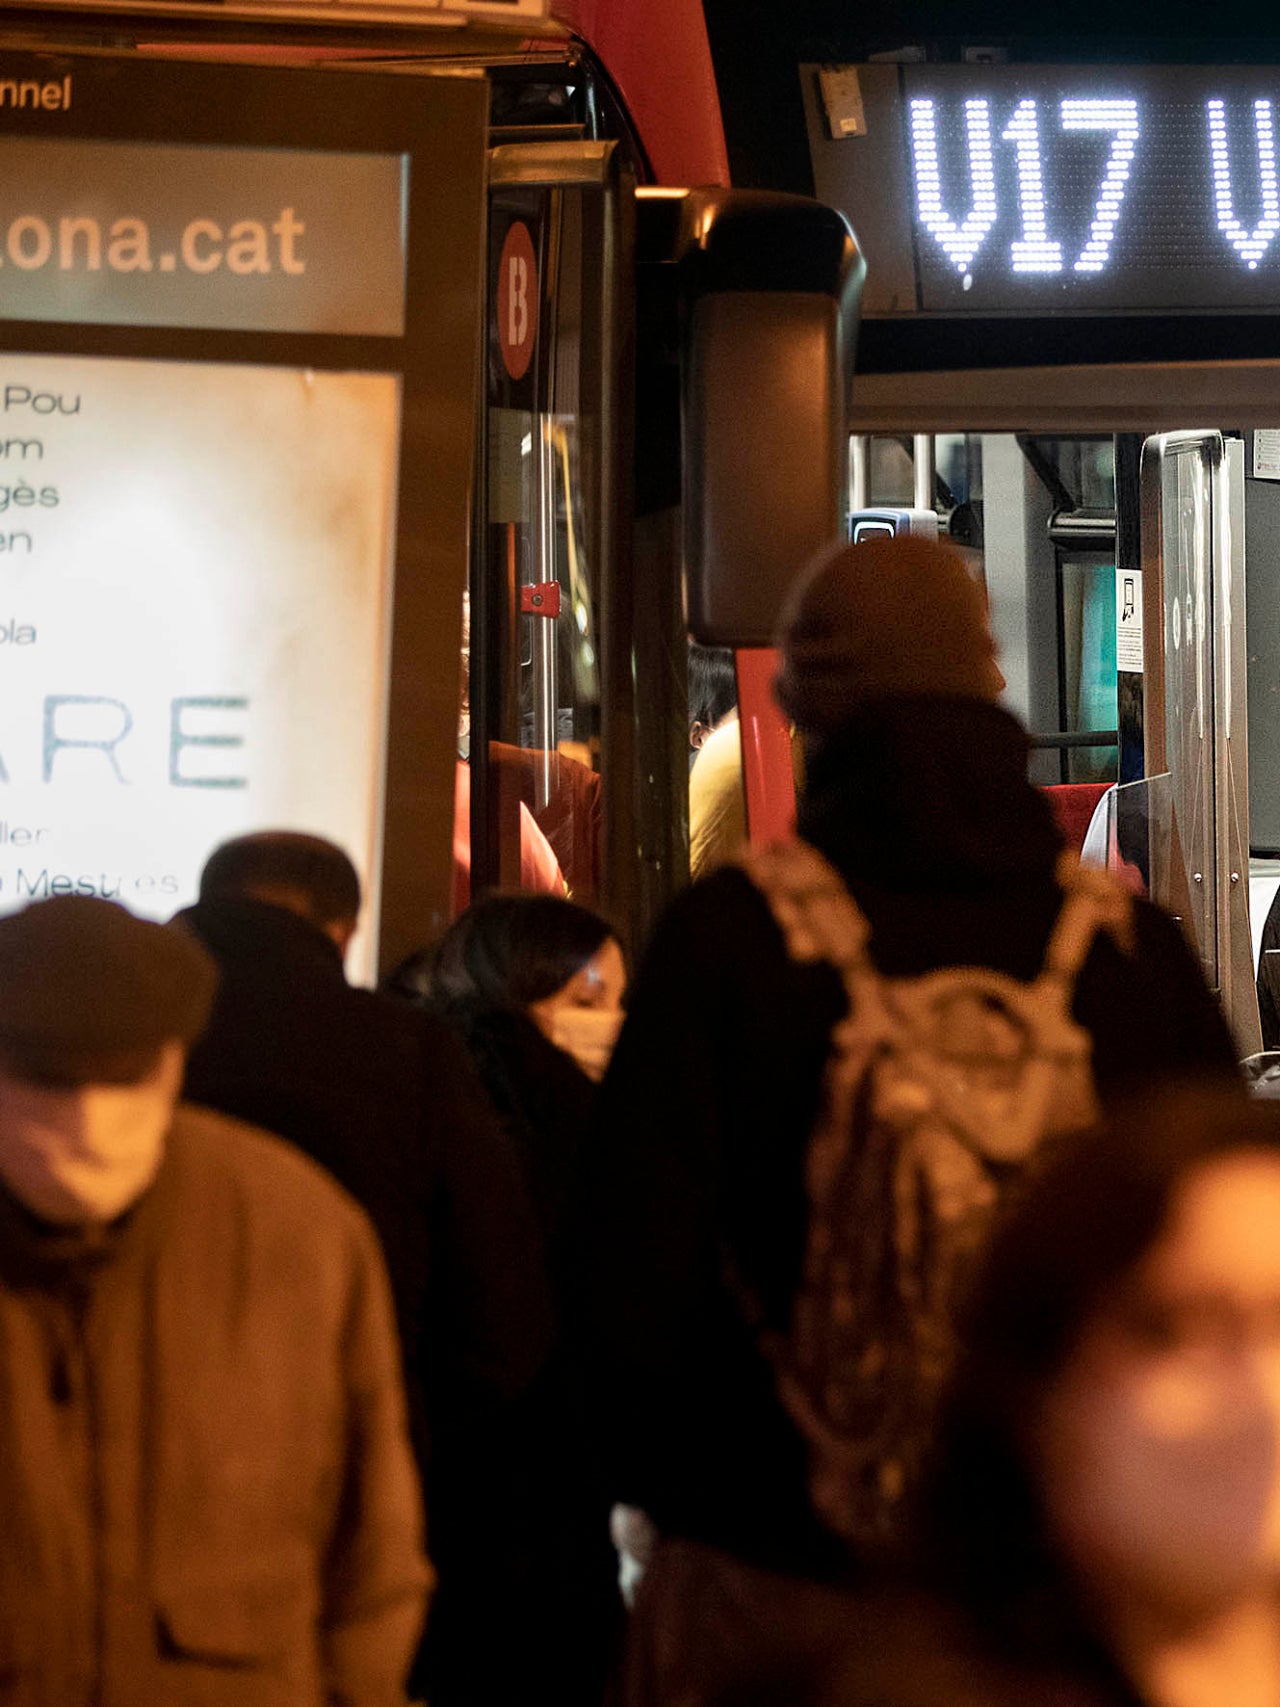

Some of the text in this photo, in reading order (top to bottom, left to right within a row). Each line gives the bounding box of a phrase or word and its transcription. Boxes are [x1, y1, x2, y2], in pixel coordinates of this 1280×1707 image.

[911, 99, 1140, 272] V17
[0, 207, 305, 275] ona.cat
[507, 256, 528, 346] B
[4, 385, 81, 415] Pou
[0, 437, 44, 460] m
[0, 693, 250, 788] RE
